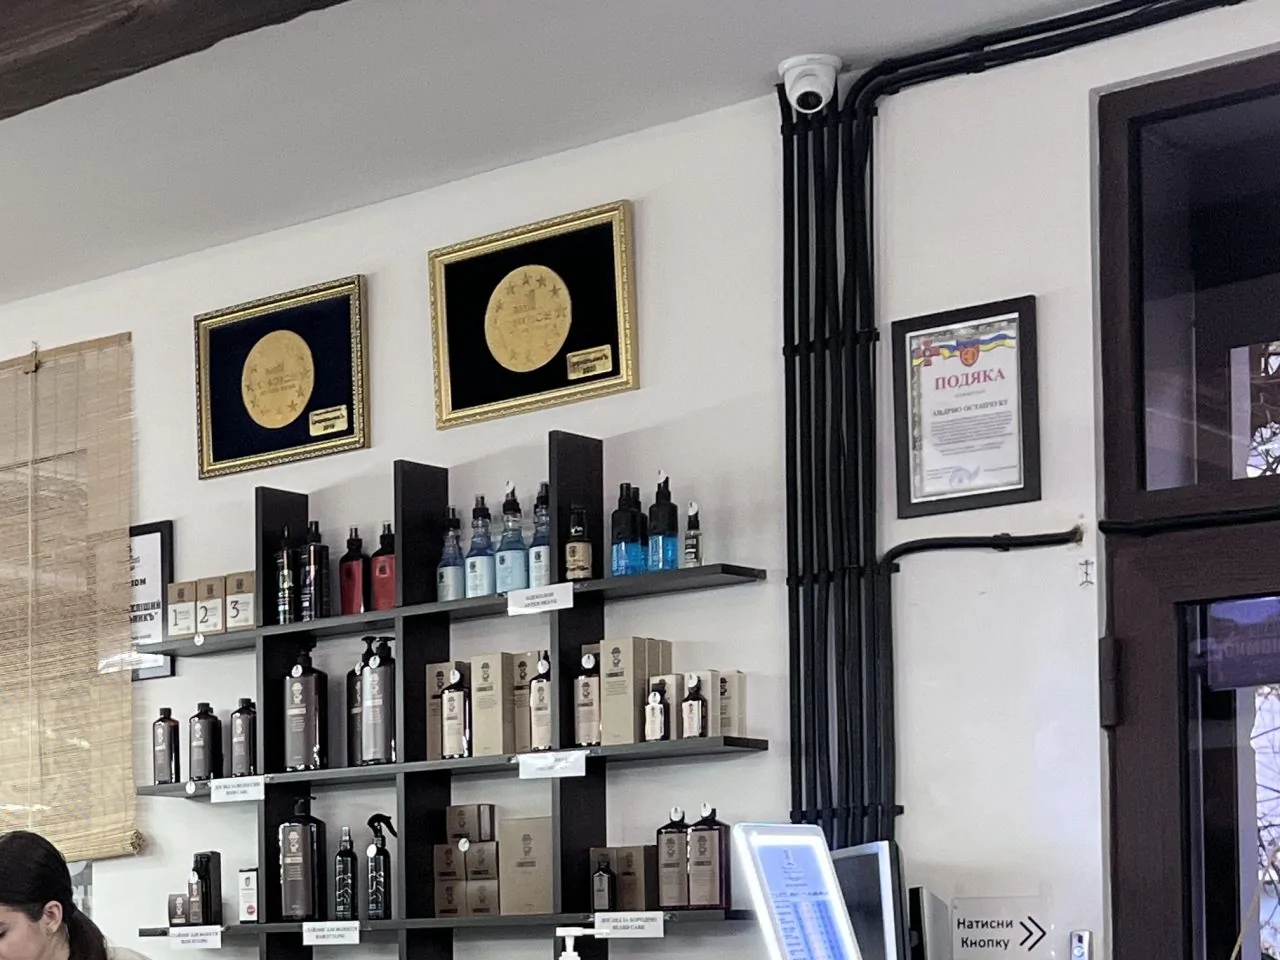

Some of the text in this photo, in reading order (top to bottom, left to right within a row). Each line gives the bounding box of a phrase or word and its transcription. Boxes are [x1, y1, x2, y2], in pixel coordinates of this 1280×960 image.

[934, 368, 1006, 390] ПОДЯКА
[172, 608, 179, 627] 1
[199, 605, 209, 624] 2
[230, 600, 239, 619] 3
[956, 918, 1014, 930] Натисни
[960, 937, 1010, 951] Кнопку
